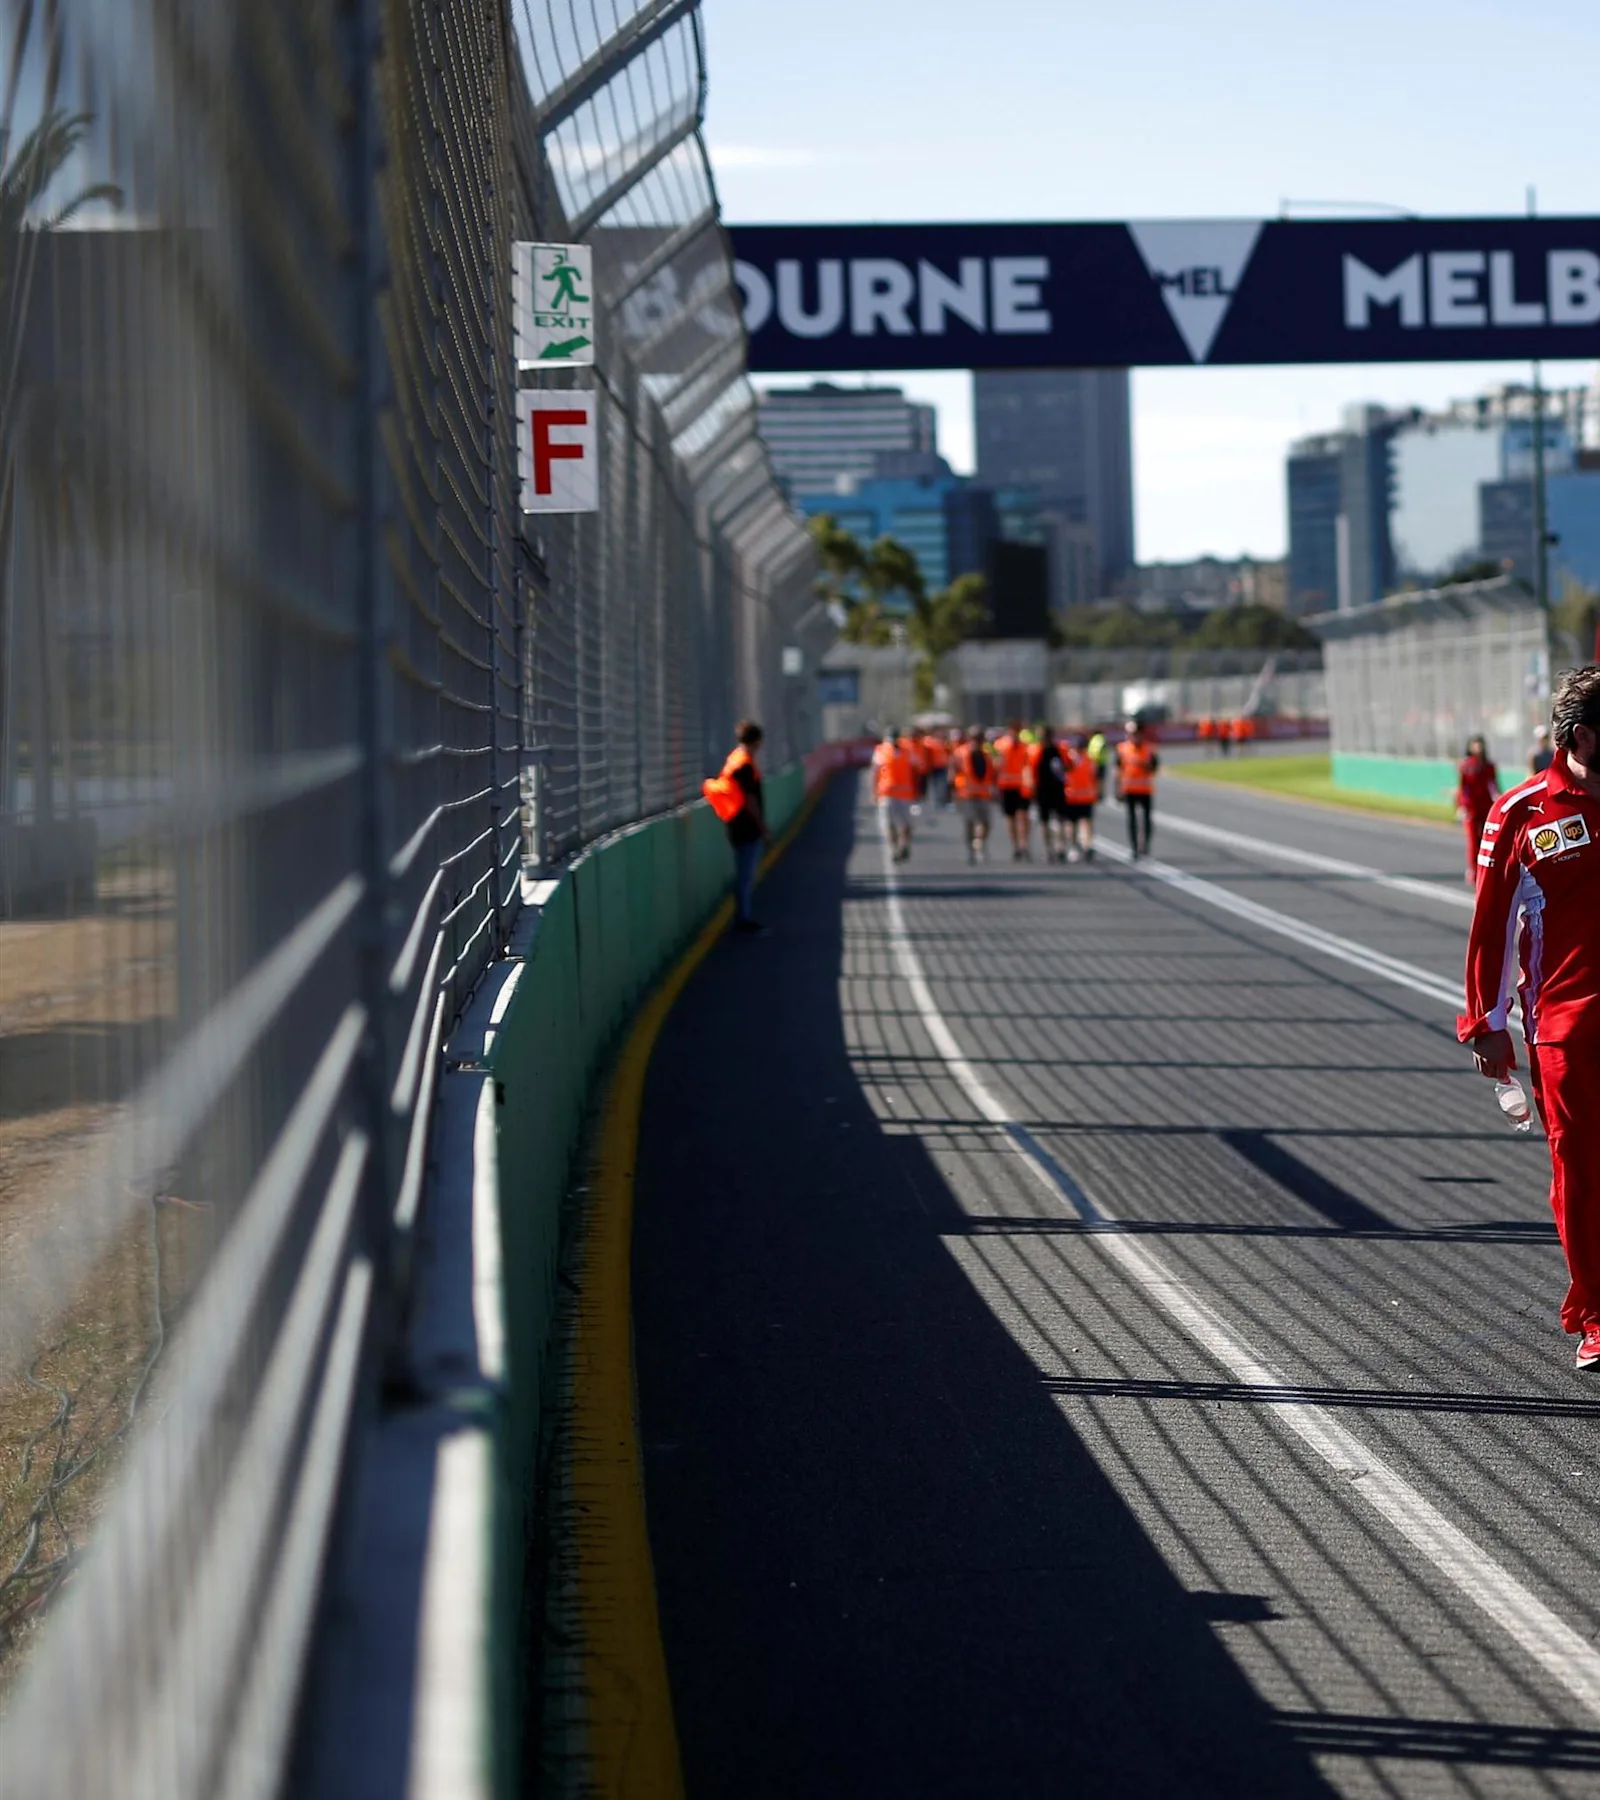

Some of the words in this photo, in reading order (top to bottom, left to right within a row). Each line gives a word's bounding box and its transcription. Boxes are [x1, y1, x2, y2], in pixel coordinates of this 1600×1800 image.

[1151, 266, 1236, 298] MEL
[533, 315, 591, 329] EXIT
[531, 410, 588, 495] F
[1564, 825, 1583, 840] ups
